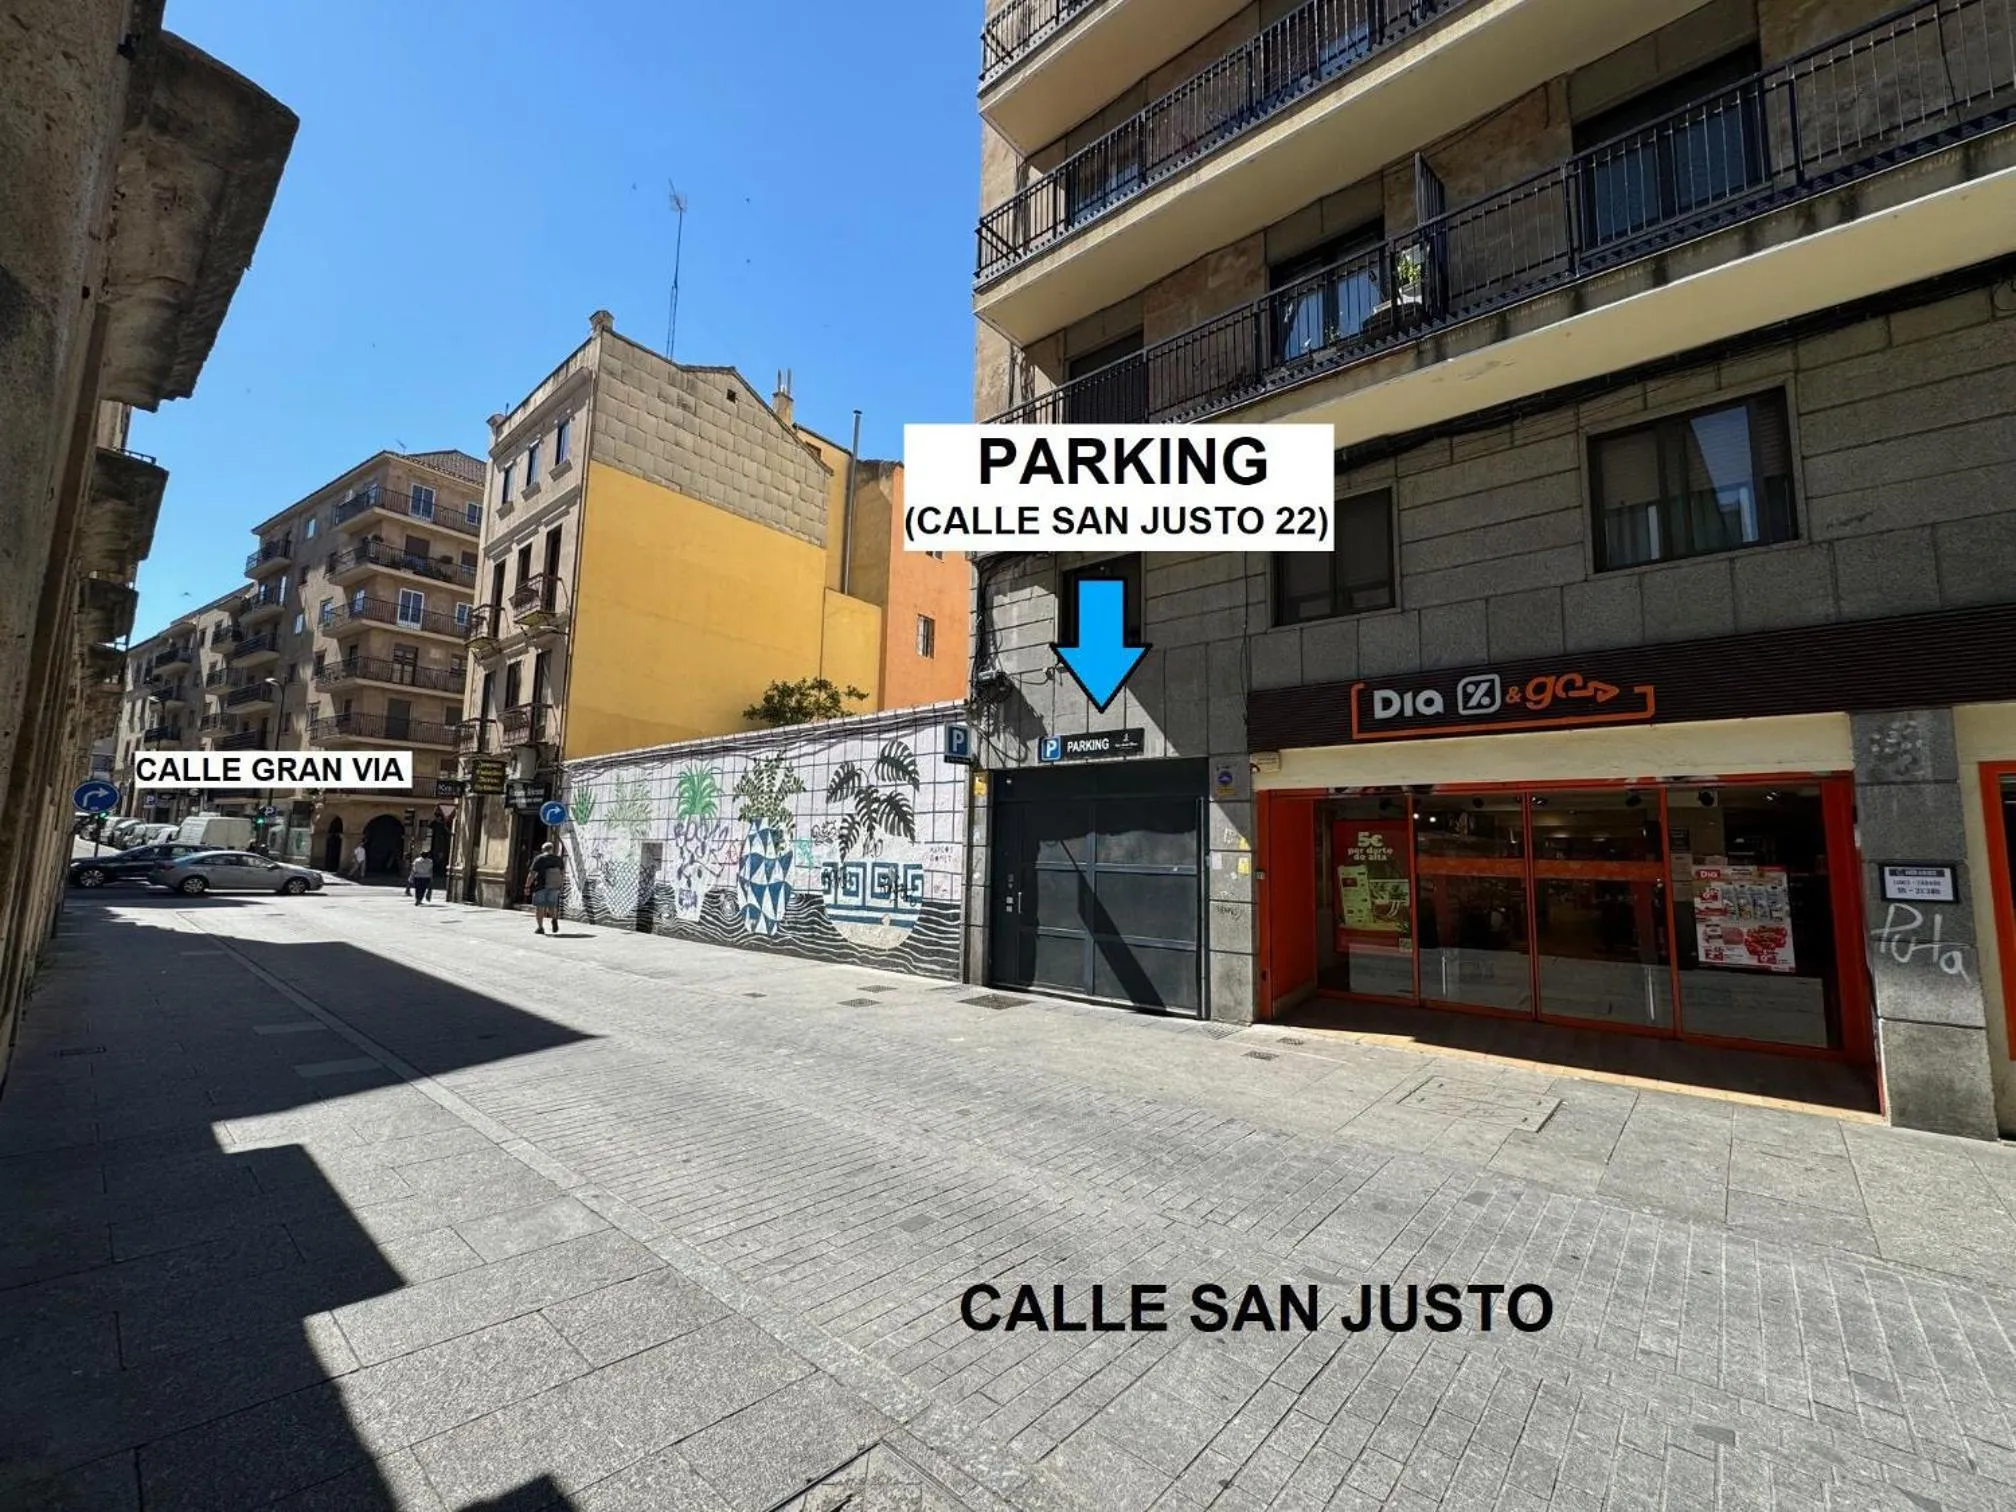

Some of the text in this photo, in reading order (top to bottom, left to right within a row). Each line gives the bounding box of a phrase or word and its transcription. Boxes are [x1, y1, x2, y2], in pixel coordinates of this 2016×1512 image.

[952, 730, 965, 752] P
[1046, 738, 1110, 757] P PARKING
[1358, 831, 1384, 847] 5€
